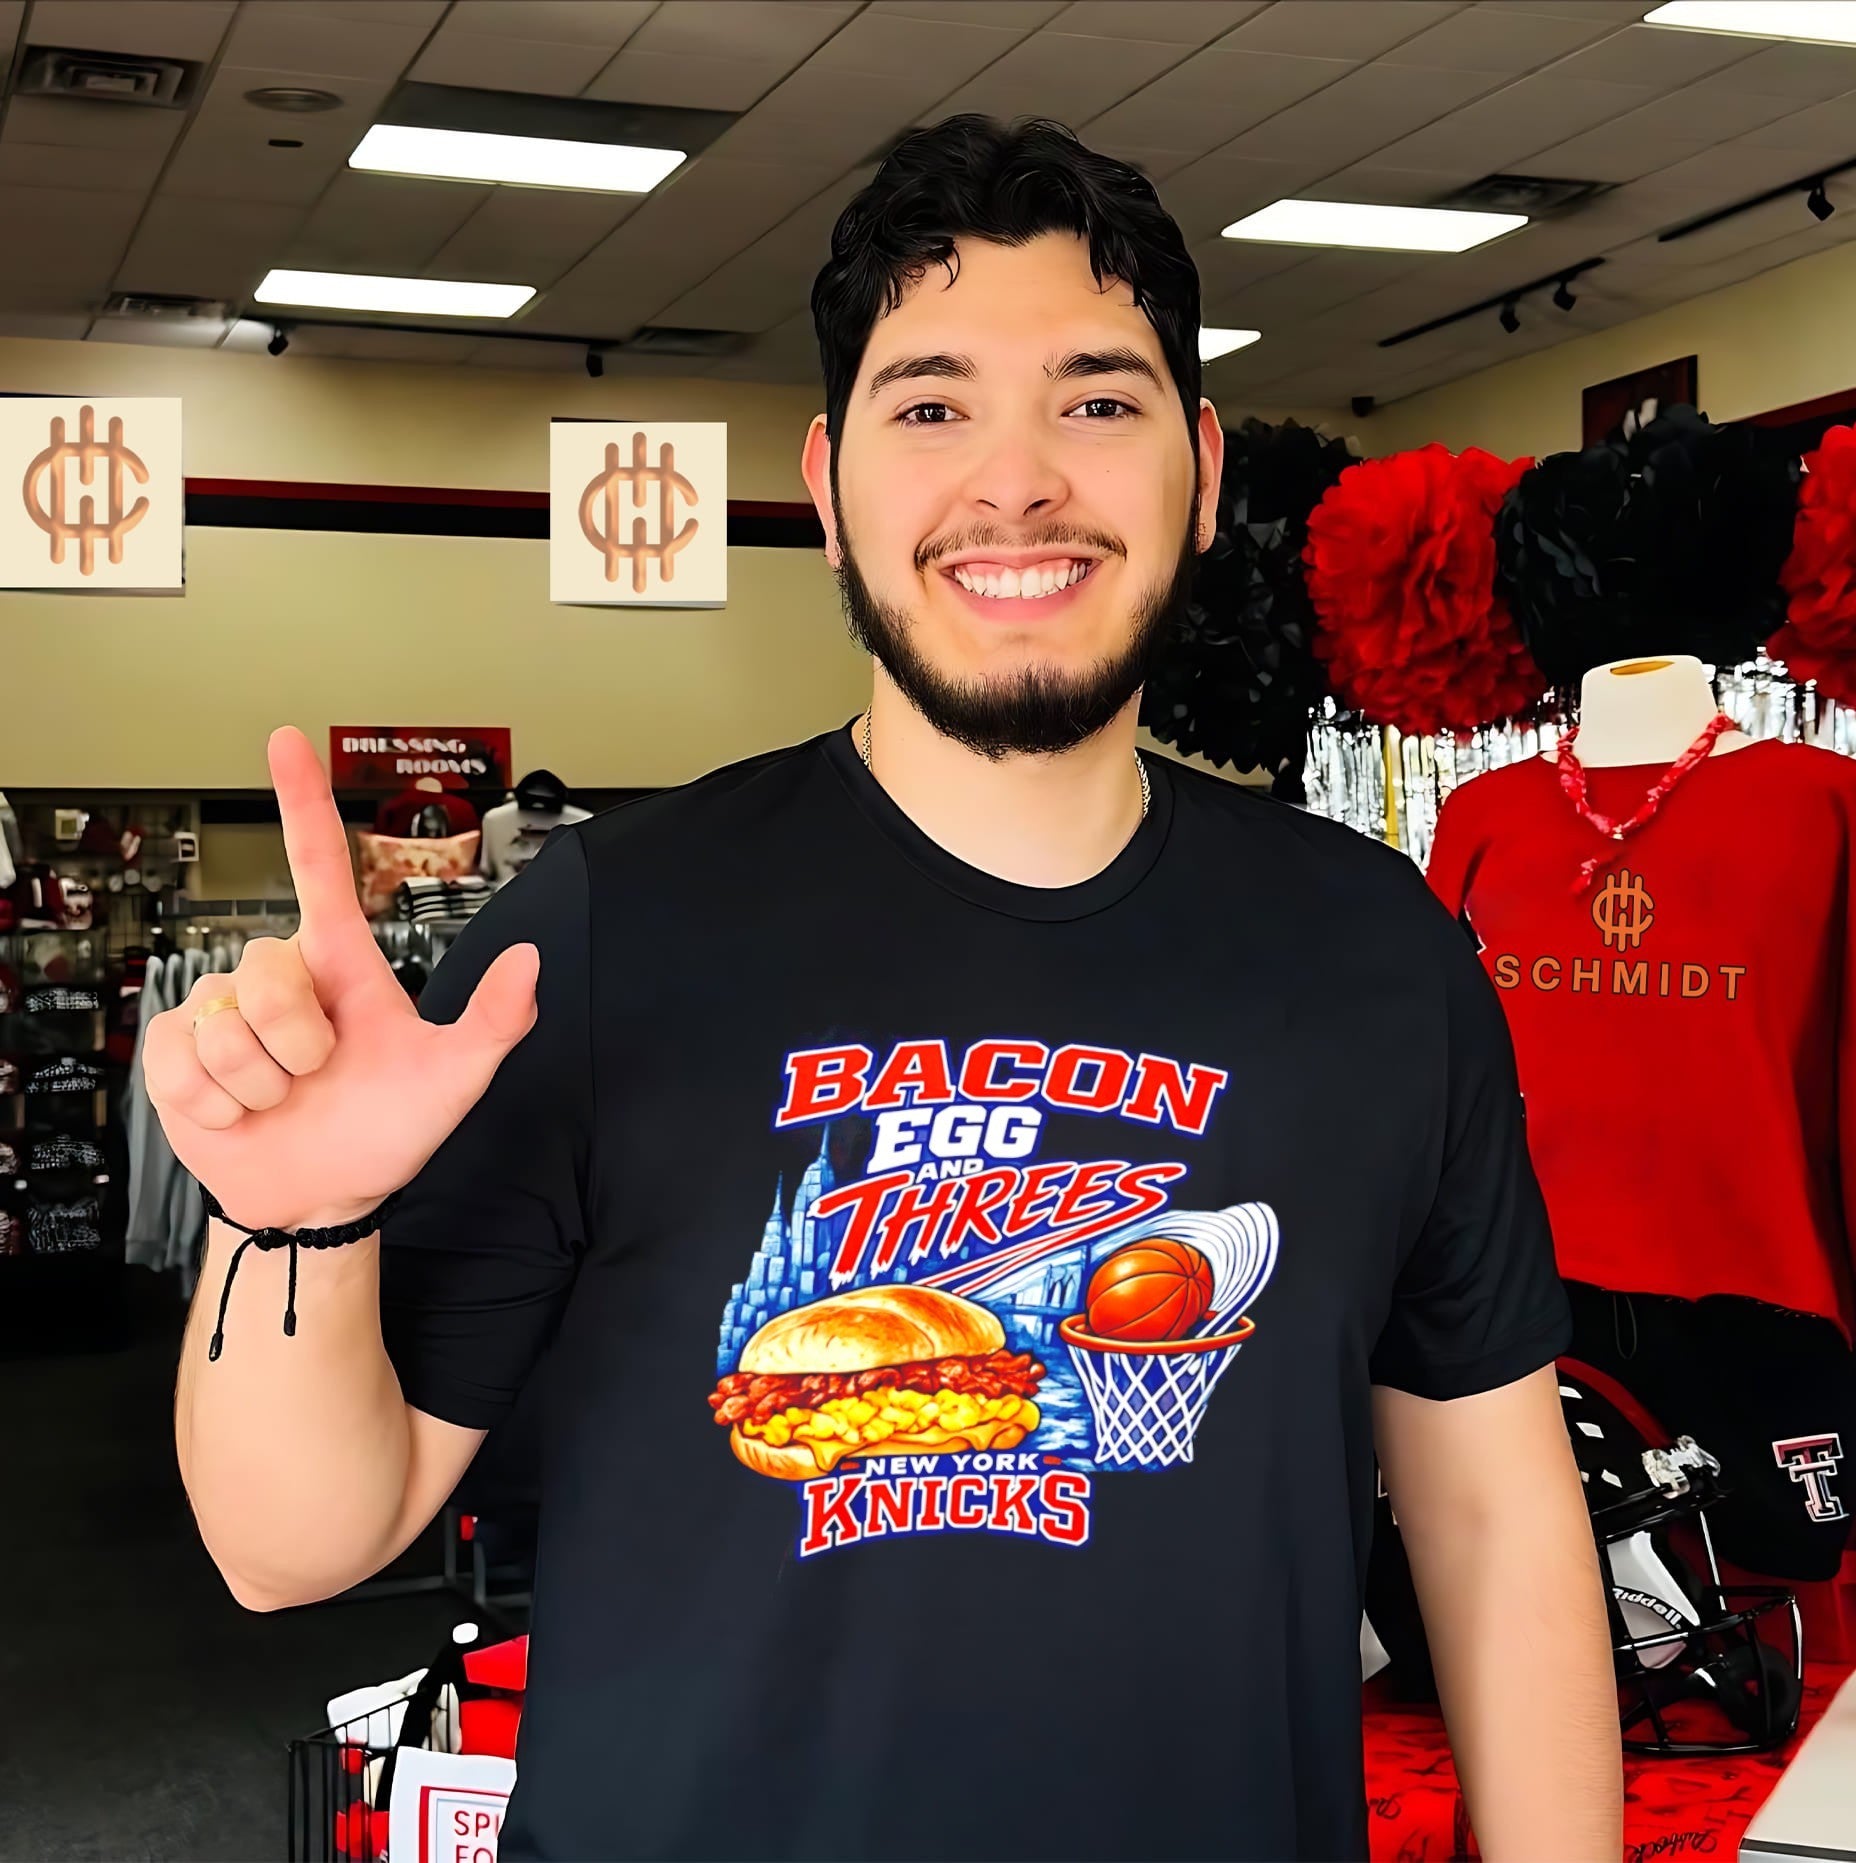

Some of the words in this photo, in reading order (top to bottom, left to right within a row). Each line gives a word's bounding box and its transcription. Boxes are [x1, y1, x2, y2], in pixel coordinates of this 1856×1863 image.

[342, 737, 466, 754] DRESSING
[396, 758, 487, 775] ROOMS
[1494, 954, 1746, 1000] SCHMIDT
[775, 1038, 1228, 1135] BACON
[867, 1105, 1043, 1174] EGG
[915, 1158, 985, 1183] AND
[808, 1161, 1187, 1291] THREES
[866, 1457, 942, 1476] NEW
[955, 1453, 1040, 1472] YORK
[801, 1473, 1090, 1556] KNICKS
